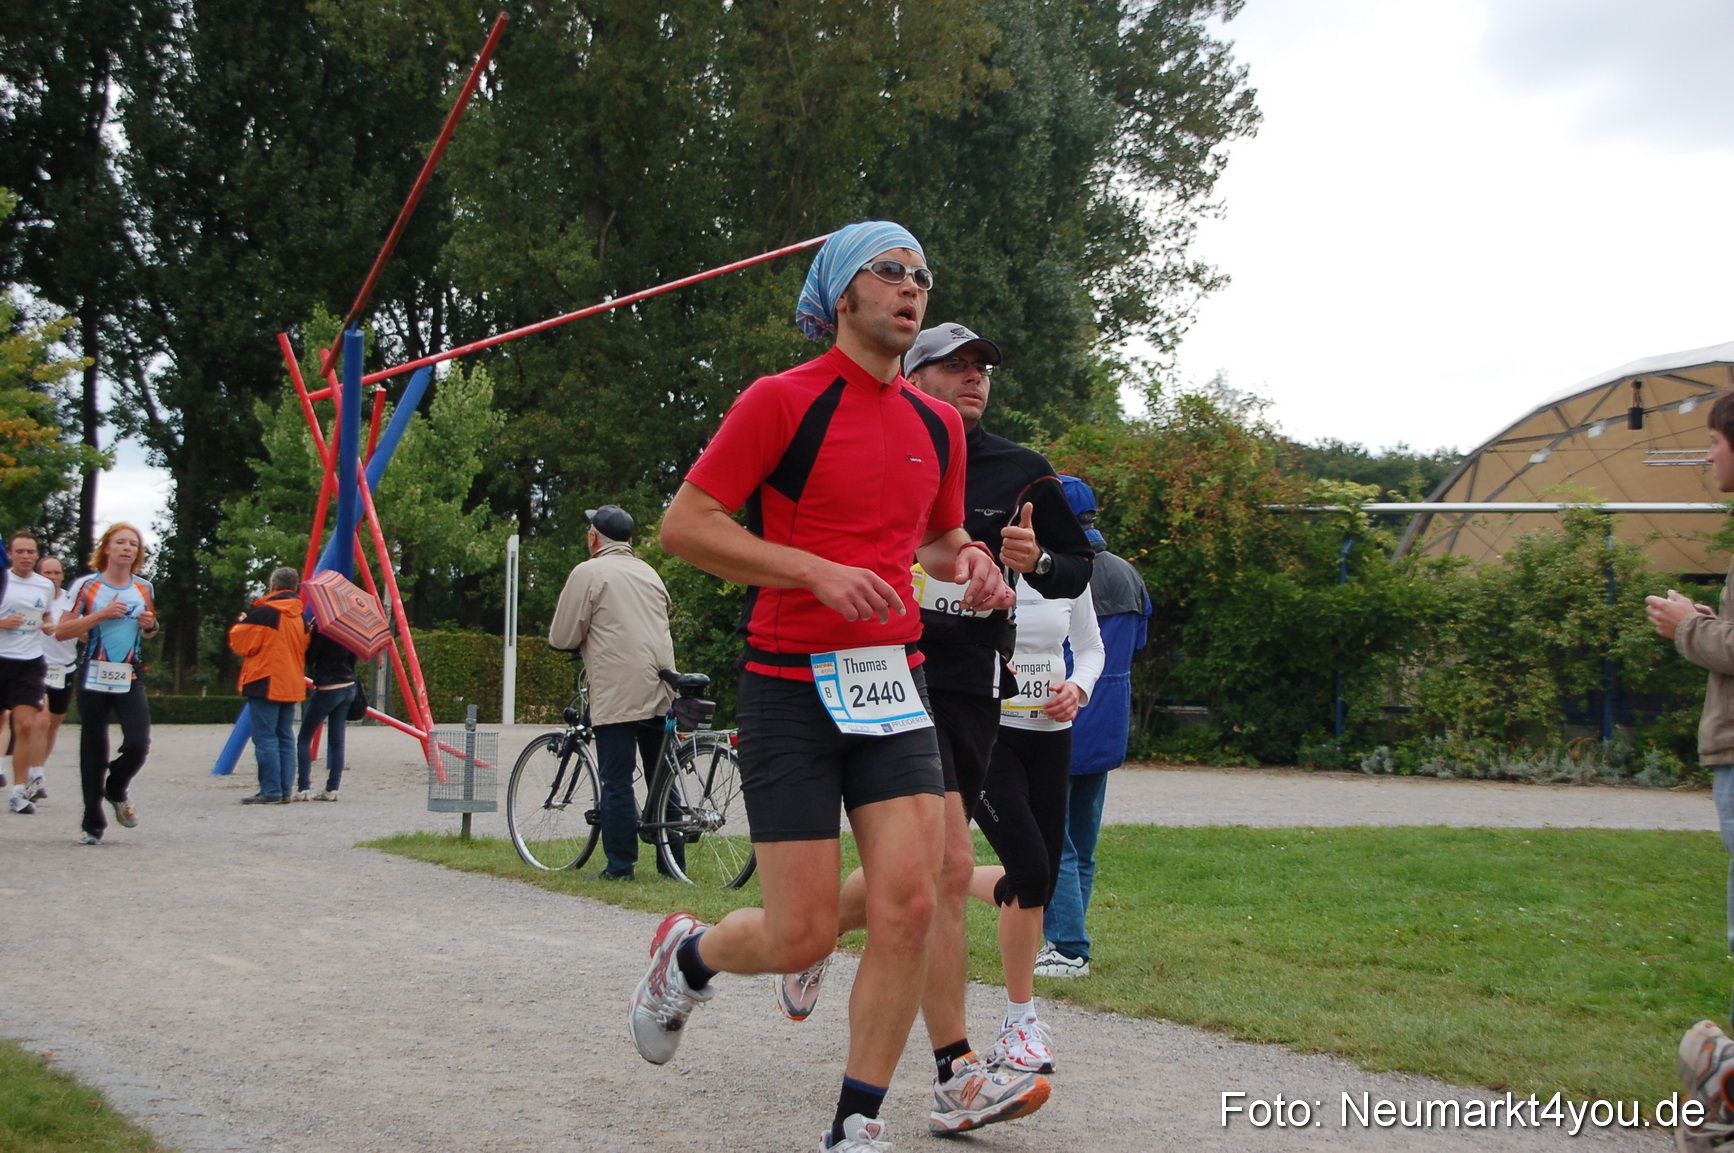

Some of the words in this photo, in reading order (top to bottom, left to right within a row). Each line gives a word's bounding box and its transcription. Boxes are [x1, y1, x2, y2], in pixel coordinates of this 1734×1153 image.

[843, 657, 887, 674] Thomas
[101, 670, 126, 681] 3524
[824, 687, 832, 698] B
[849, 680, 906, 708] 2440
[891, 716, 930, 728] PFLEIDERER
